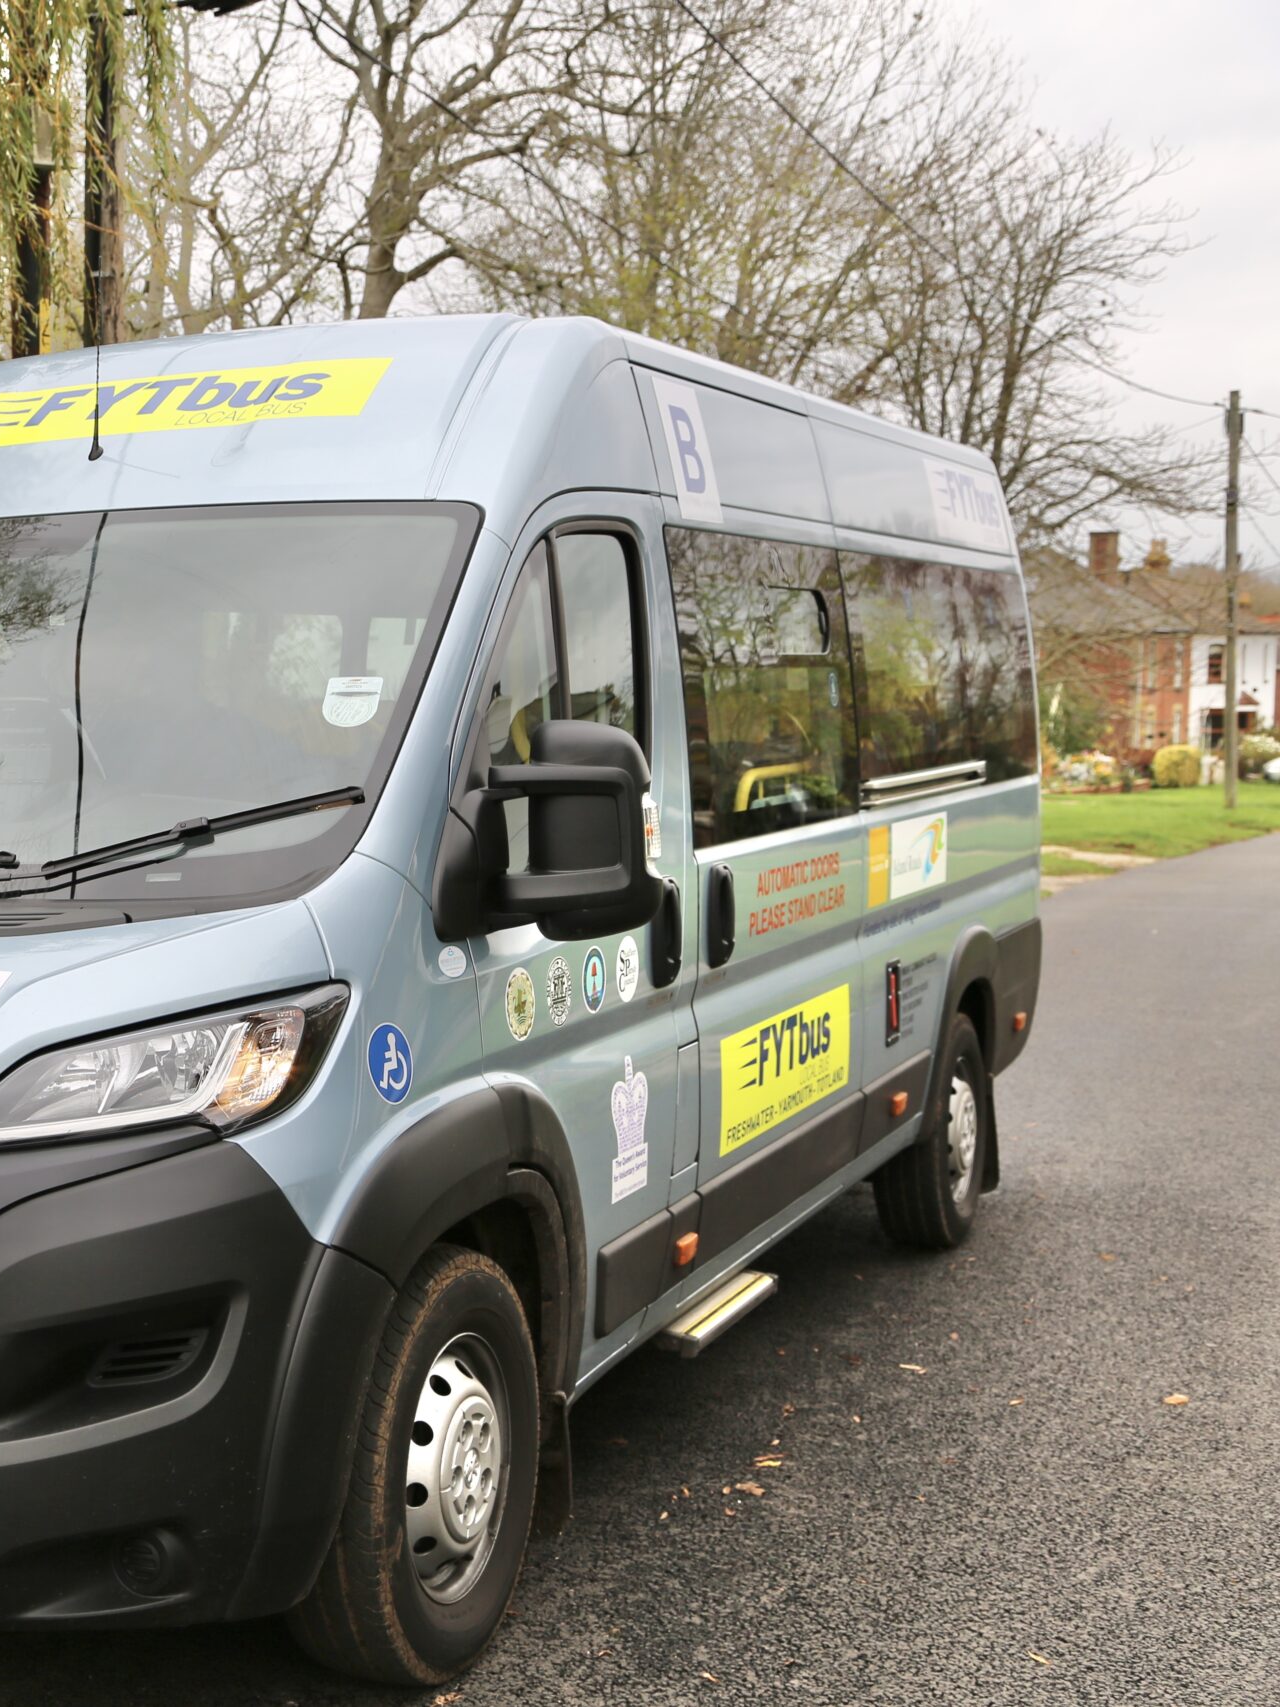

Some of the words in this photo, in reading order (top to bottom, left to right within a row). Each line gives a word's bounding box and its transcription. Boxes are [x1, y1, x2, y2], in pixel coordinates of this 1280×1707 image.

[23, 372, 332, 427] FYTbus
[174, 409, 247, 426] LOCAL
[255, 402, 307, 418] BUS
[668, 404, 706, 493] B
[757, 861, 808, 897] AUTOMATIC
[810, 851, 839, 882] DOORS
[748, 902, 786, 937] PLEASE
[787, 893, 816, 925] STAND
[819, 883, 845, 914] CLEAR
[758, 1011, 831, 1086] FYTbus
[726, 1104, 774, 1147] FRESHWATER
[779, 1083, 813, 1116] YARMOUTH
[817, 1066, 844, 1093] TOTLAND
